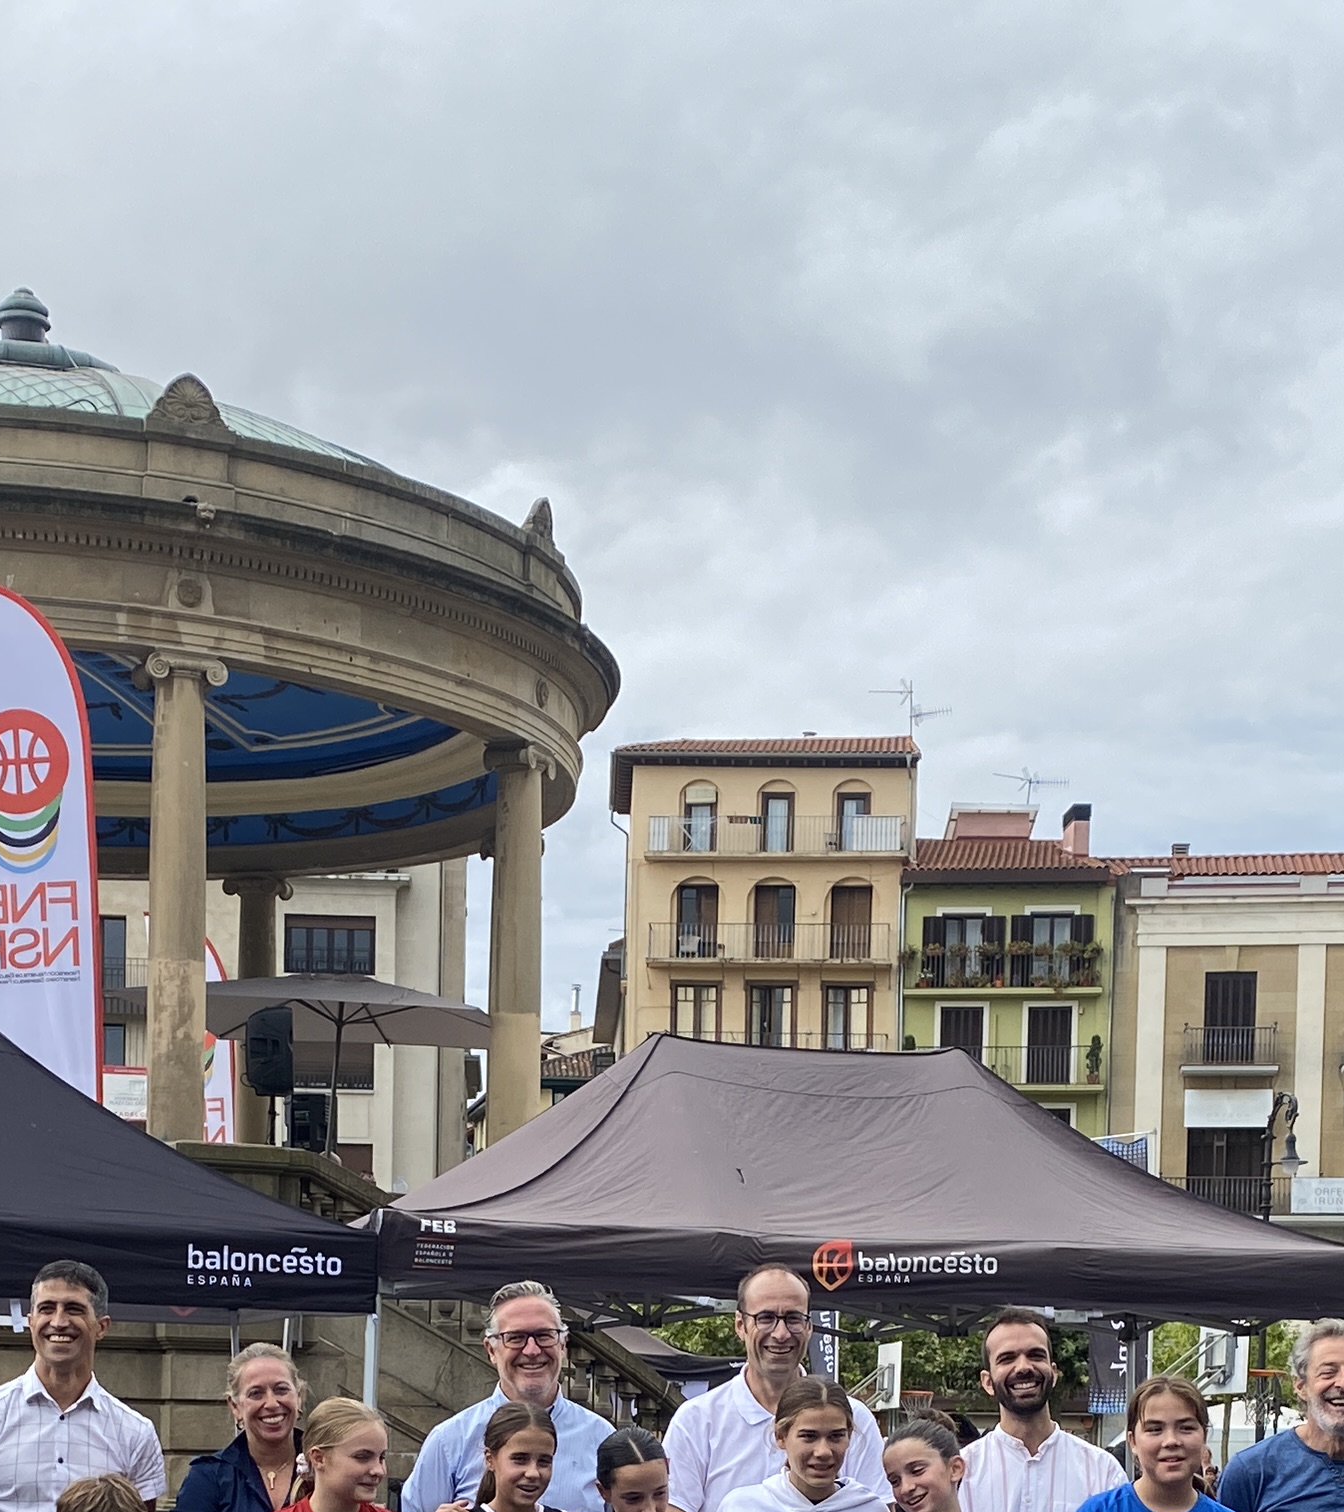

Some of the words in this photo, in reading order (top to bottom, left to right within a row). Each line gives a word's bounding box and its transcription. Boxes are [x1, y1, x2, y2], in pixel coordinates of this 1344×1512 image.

[420, 1218, 457, 1234] FEB
[187, 1274, 252, 1288] ESPAÑA
[858, 1273, 910, 1284] ESPAÑA
